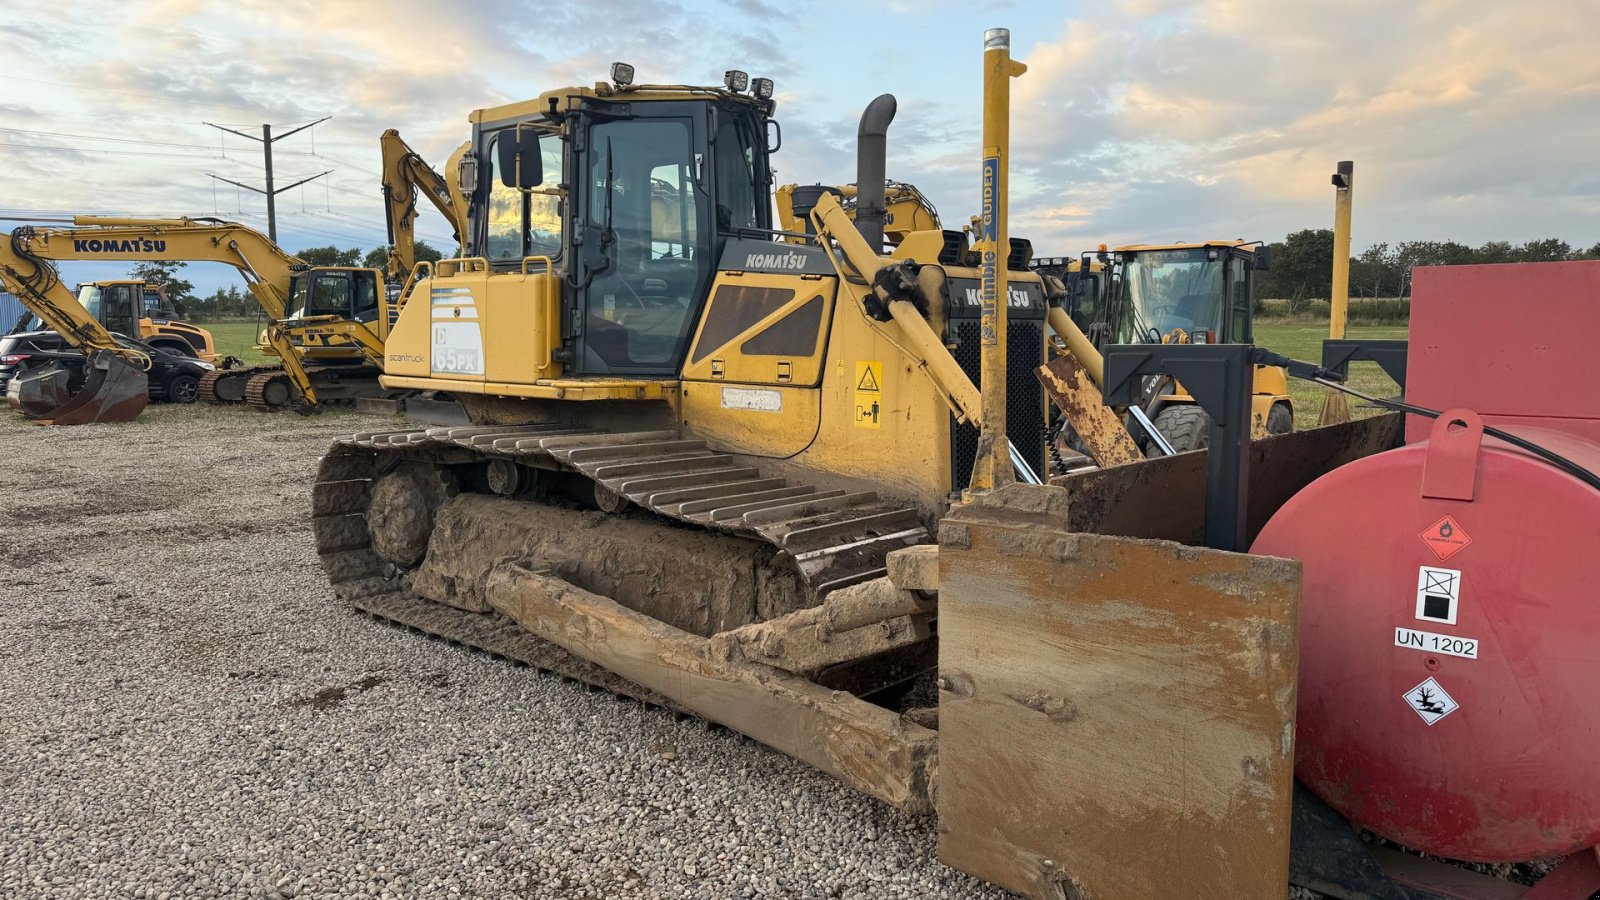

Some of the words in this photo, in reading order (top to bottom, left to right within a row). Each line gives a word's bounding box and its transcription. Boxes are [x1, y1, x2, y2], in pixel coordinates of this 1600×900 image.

[983, 165, 994, 227] GUIDED
[74, 236, 166, 253] KOMATSU
[745, 251, 808, 269] KOMATSU
[389, 353, 424, 363] scantruck
[1397, 630, 1424, 648] UN
[1431, 636, 1475, 656] 1202
